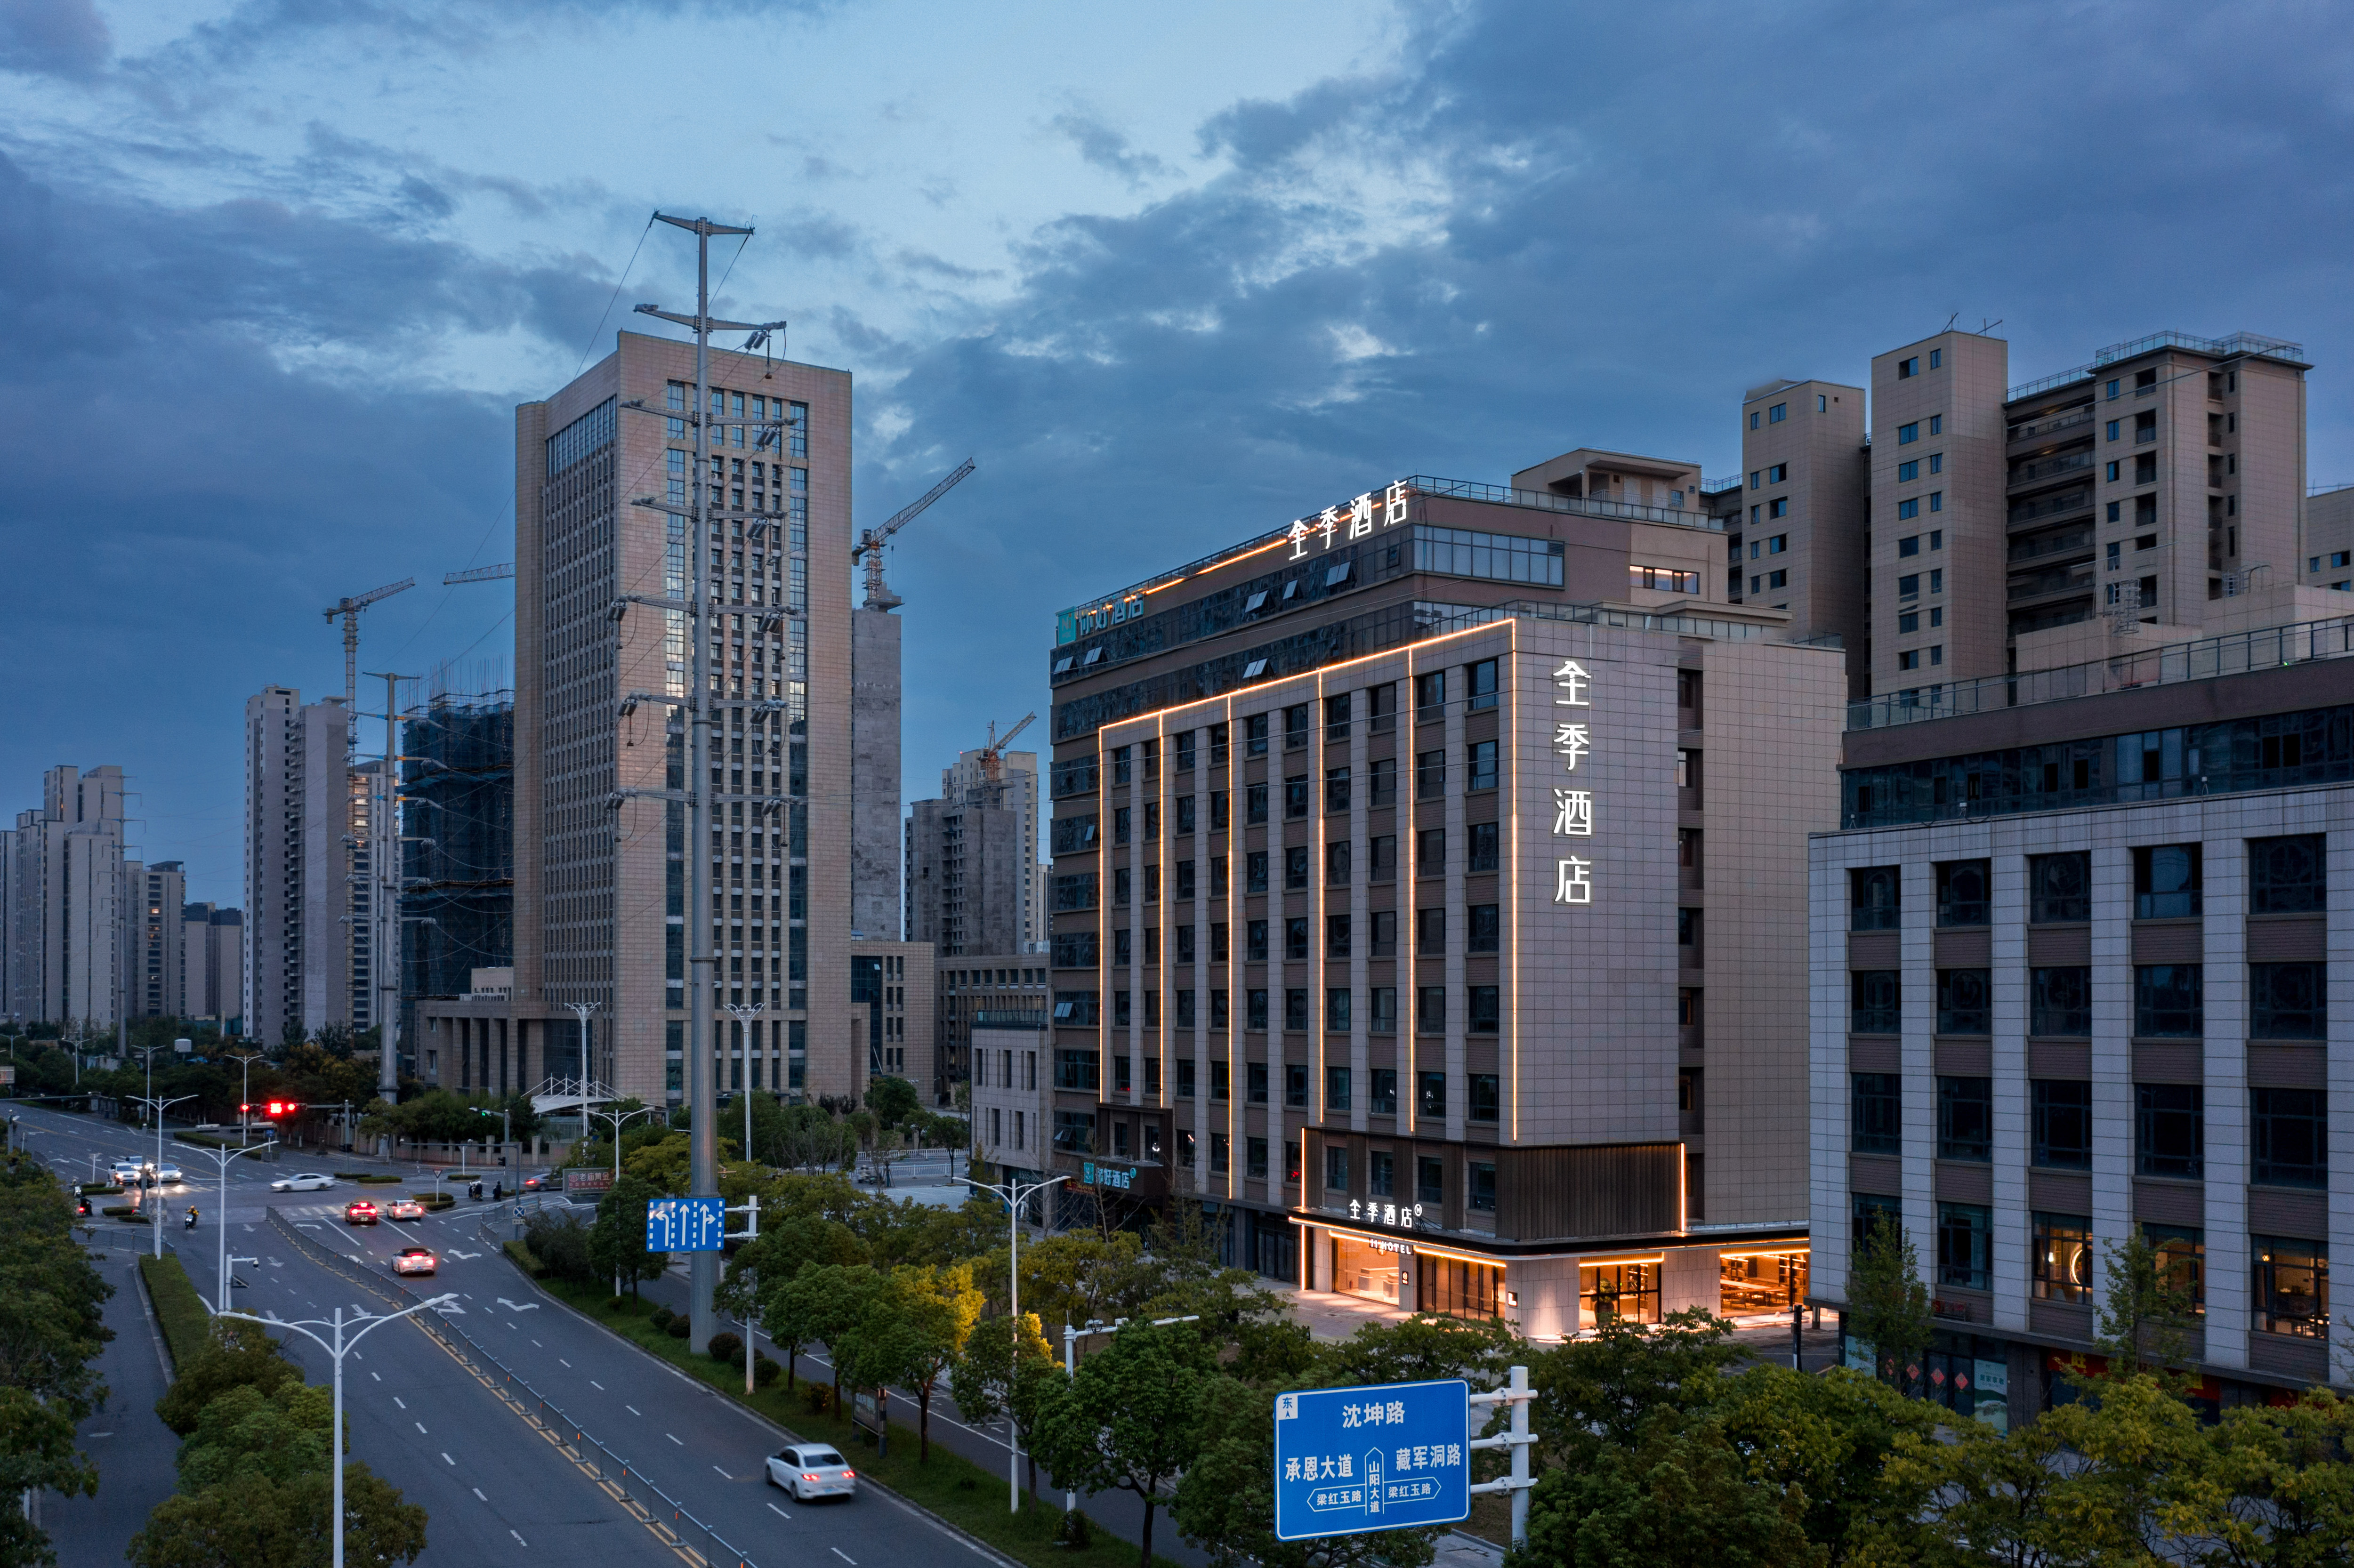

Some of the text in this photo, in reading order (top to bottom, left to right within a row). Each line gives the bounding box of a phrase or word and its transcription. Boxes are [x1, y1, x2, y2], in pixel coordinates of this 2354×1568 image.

[1288, 480, 1407, 560] 全季酒店
[1553, 660, 1591, 903] 全季酒店
[1096, 1167, 1129, 1189] 你好酒店
[1349, 1199, 1412, 1228] 全季酒店
[1381, 1241, 1411, 1254] HOTEL
[1282, 1397, 1293, 1409] 东
[1342, 1400, 1405, 1428] 沈坤路
[1285, 1454, 1353, 1482] 承恩大道
[1396, 1443, 1461, 1472] 藏军洞路
[1316, 1490, 1362, 1506] 梁红玉路
[1369, 1461, 1380, 1513] 山阳大道
[1388, 1483, 1431, 1498] 梁红玉路
